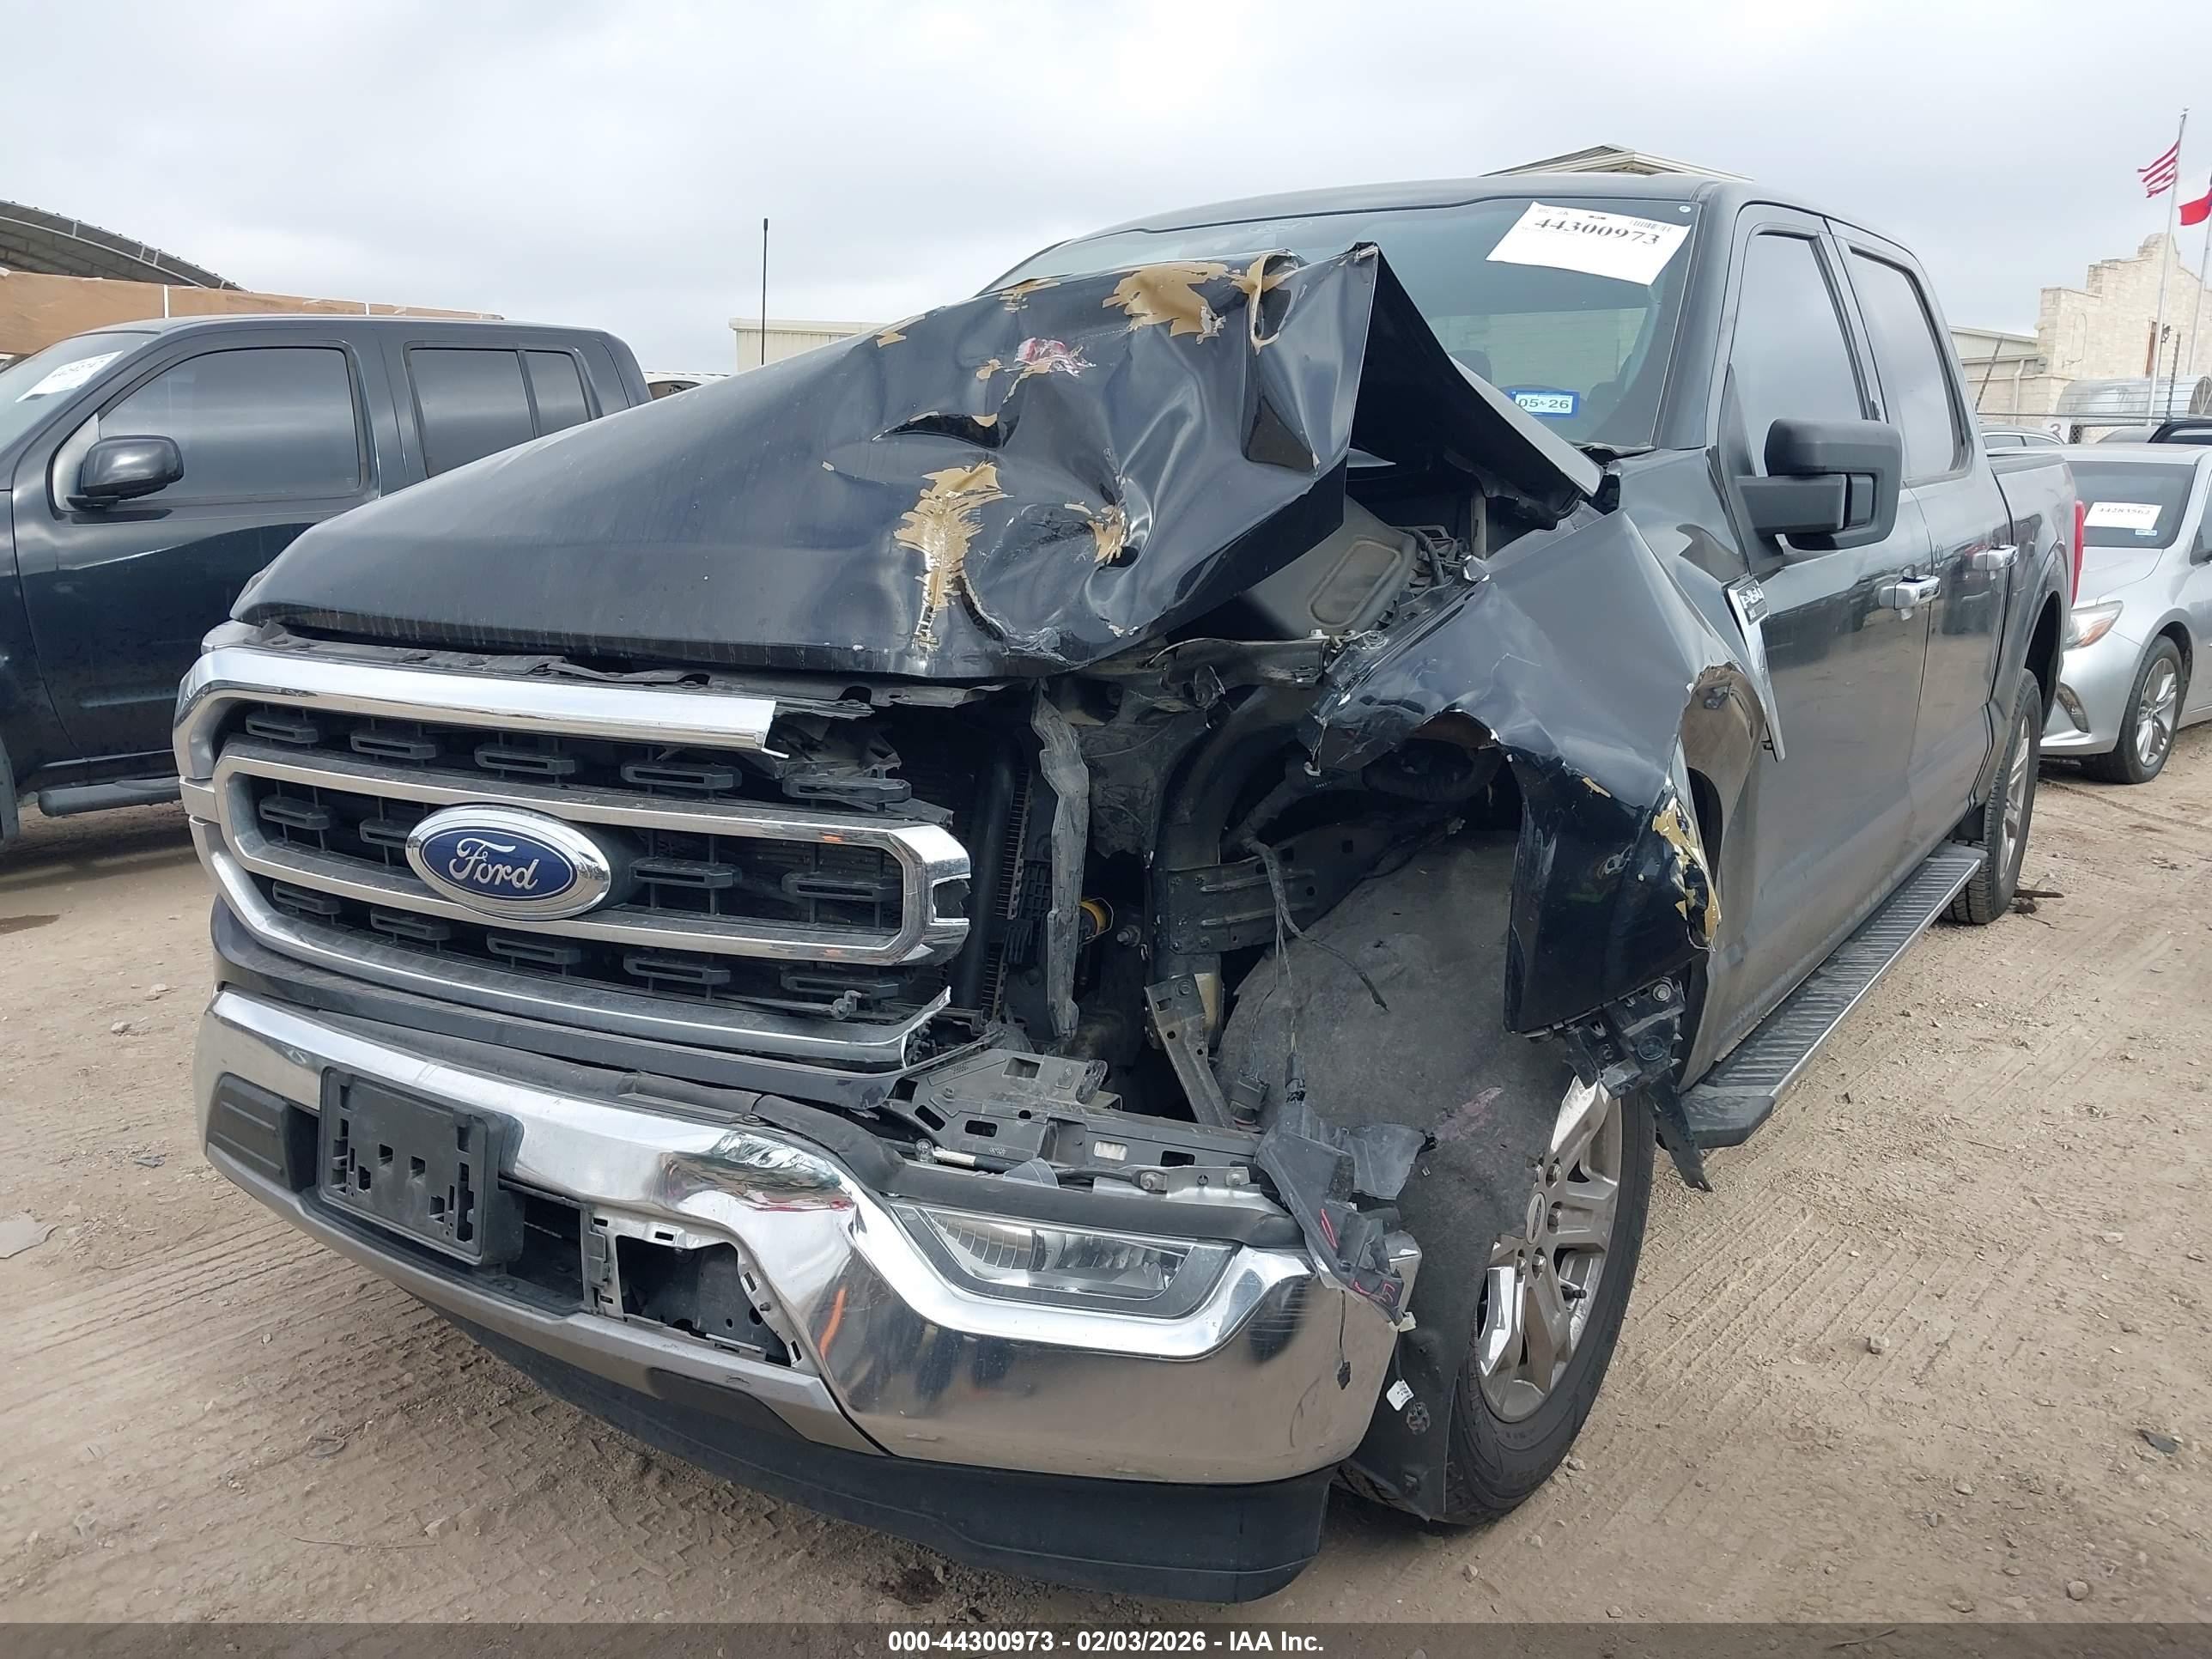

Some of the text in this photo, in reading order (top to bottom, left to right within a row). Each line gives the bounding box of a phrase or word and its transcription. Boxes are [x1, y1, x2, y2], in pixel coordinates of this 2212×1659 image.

[1534, 217, 1661, 246] 44300973
[1518, 398, 1570, 410] 05 26
[449, 838, 539, 890] Ford
